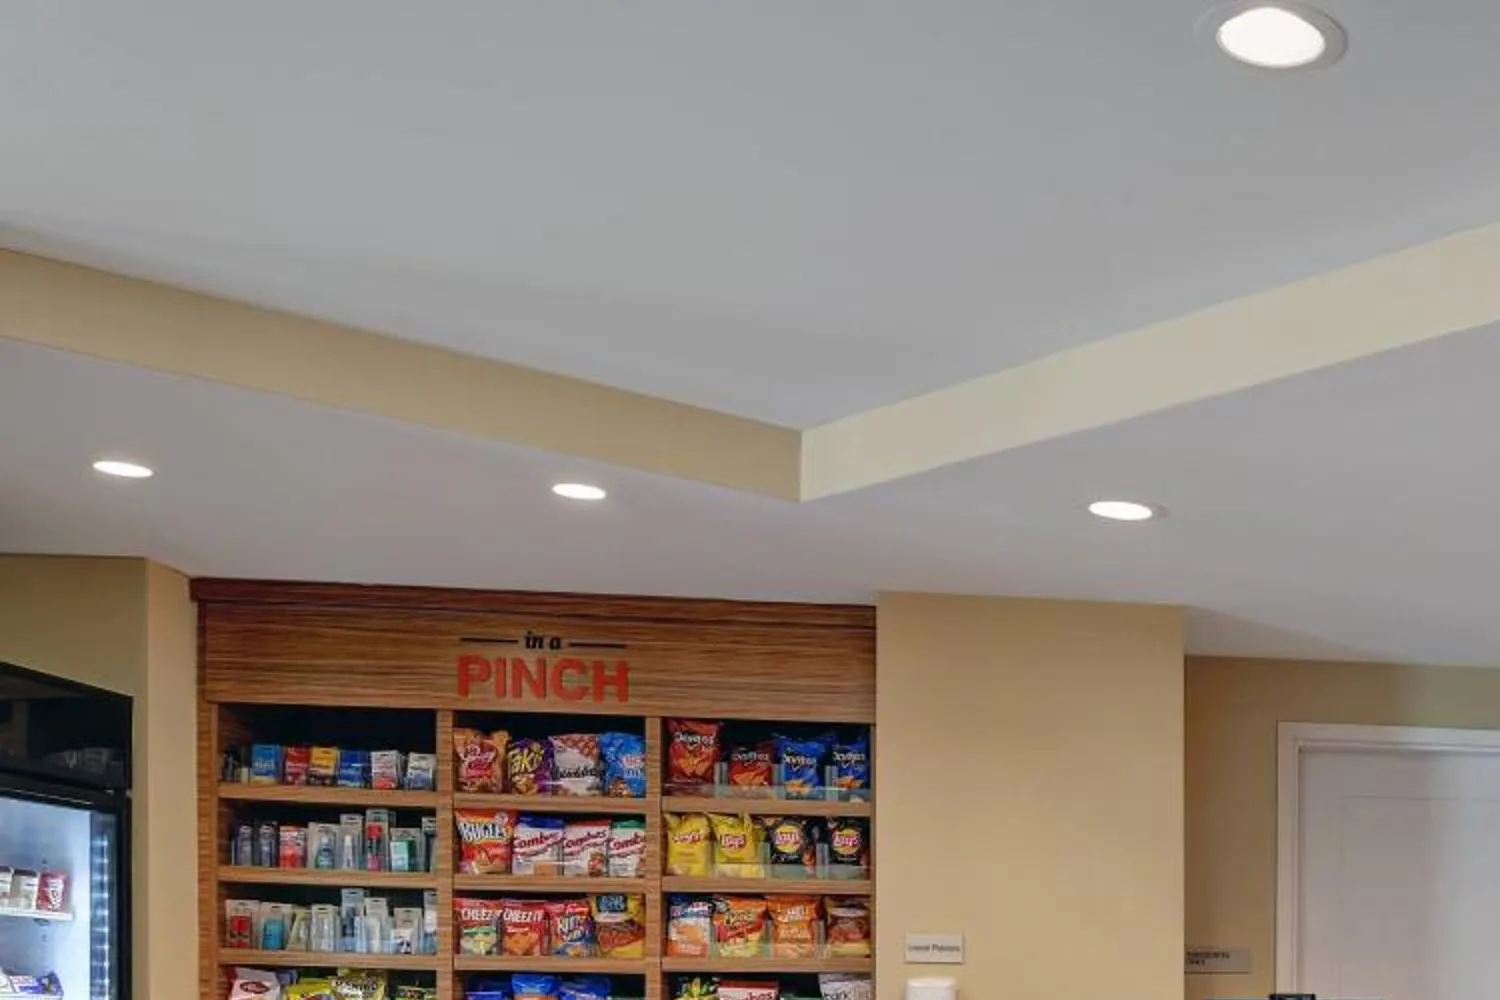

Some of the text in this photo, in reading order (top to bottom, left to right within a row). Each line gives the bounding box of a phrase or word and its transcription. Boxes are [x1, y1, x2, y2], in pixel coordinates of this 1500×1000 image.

[524, 632, 561, 649] in a
[458, 655, 629, 703] PINCH
